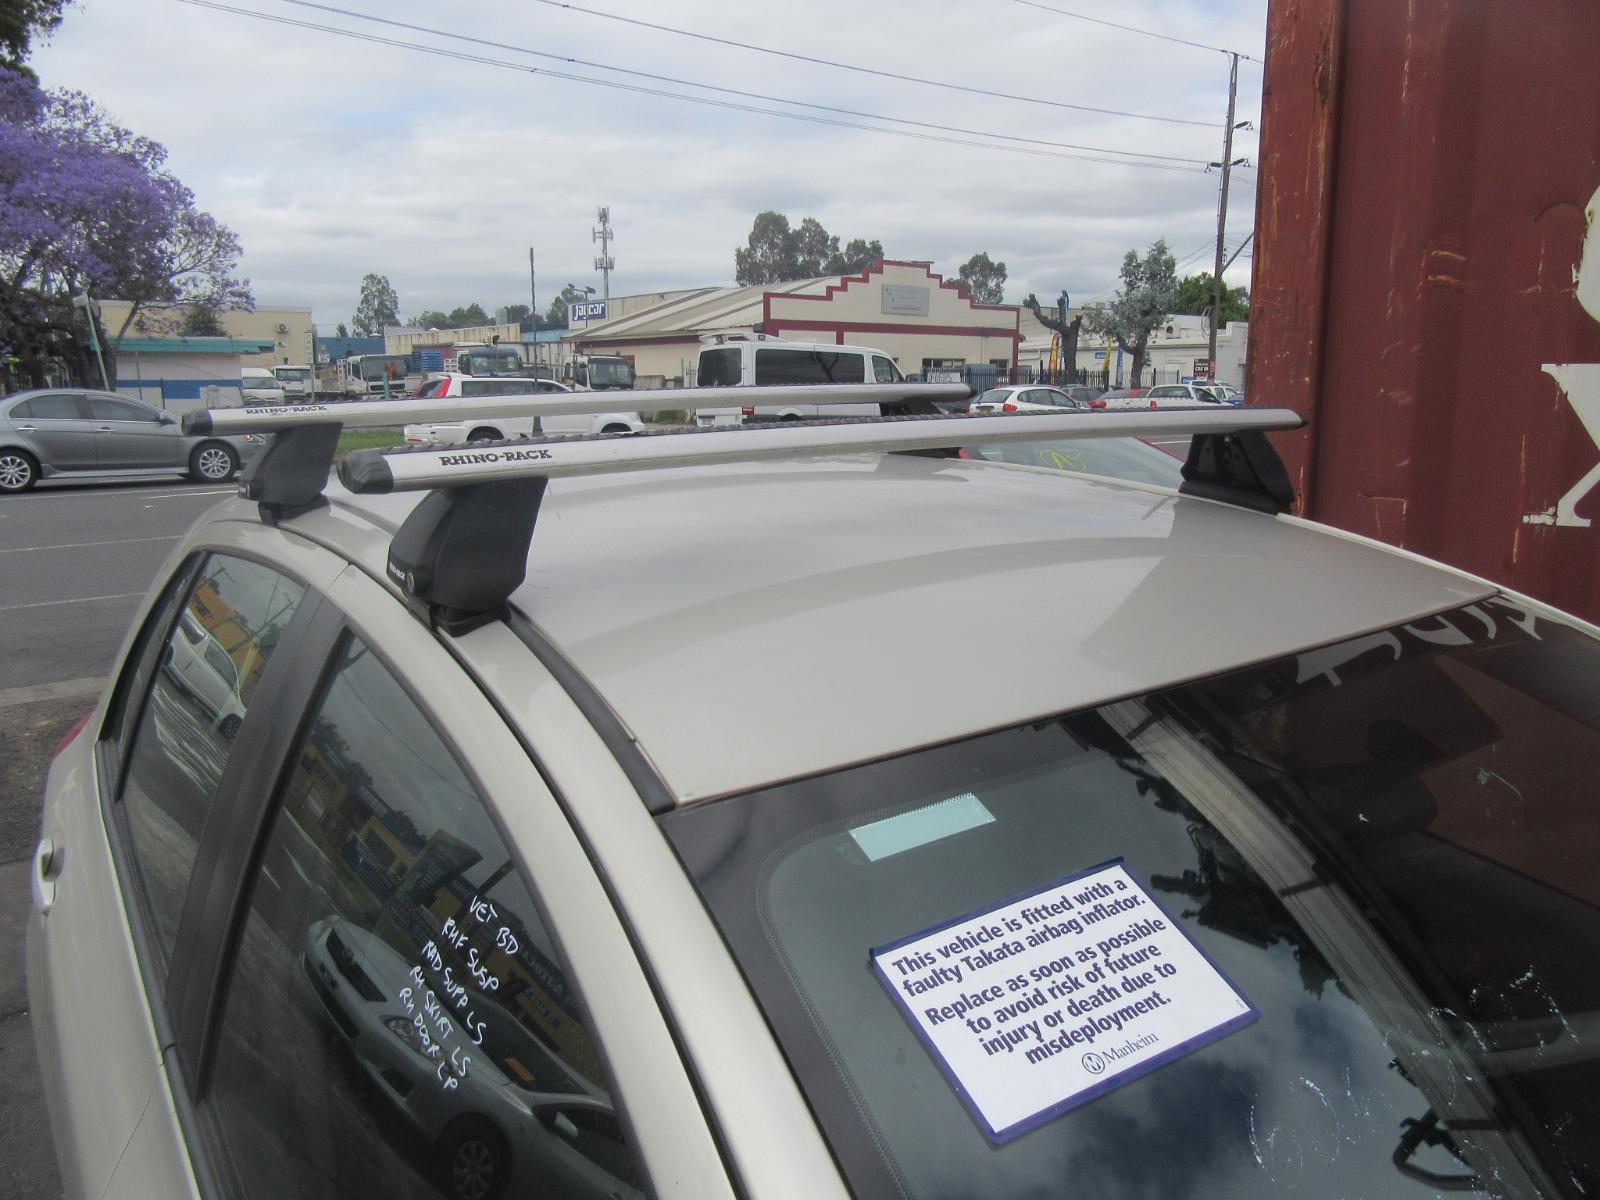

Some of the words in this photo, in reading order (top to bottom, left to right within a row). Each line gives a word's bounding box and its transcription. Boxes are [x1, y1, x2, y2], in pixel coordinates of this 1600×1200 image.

[244, 405, 327, 415] RHINO-RACK
[439, 449, 552, 466] RHINO-RACK
[469, 896, 498, 923] VET
[496, 927, 518, 954] BD
[892, 952, 937, 976] This
[936, 923, 1004, 959] vehicle
[1005, 916, 1023, 933] is
[1020, 896, 1075, 925] fitted
[1073, 881, 1115, 906] with
[1114, 879, 1128, 891] a
[903, 965, 963, 997] faulty
[960, 941, 1026, 972] Takata
[1025, 924, 1084, 948] airbag
[1077, 894, 1146, 926] inflator.
[444, 967, 468, 1008] SUPP
[467, 948, 499, 990] SUSP
[924, 993, 1005, 1026] Replace
[1005, 974, 1030, 992] as
[1029, 955, 1075, 983] soon
[1075, 946, 1098, 963] as
[1096, 918, 1166, 958] possible
[966, 1018, 992, 1034] to
[993, 987, 1048, 1023] avoid
[1047, 974, 1085, 1000] risk
[1085, 962, 1106, 984] of
[1103, 944, 1162, 974] future
[414, 1012, 440, 1058] DOOR
[425, 991, 454, 1038] SKIRT
[979, 1019, 1044, 1056] injury
[1043, 1009, 1065, 1028] or
[1067, 984, 1122, 1018] death
[1121, 971, 1156, 993] due
[1154, 962, 1177, 978] to
[1025, 990, 1172, 1065] misdeployment.
[1102, 1033, 1160, 1063] Manheim
